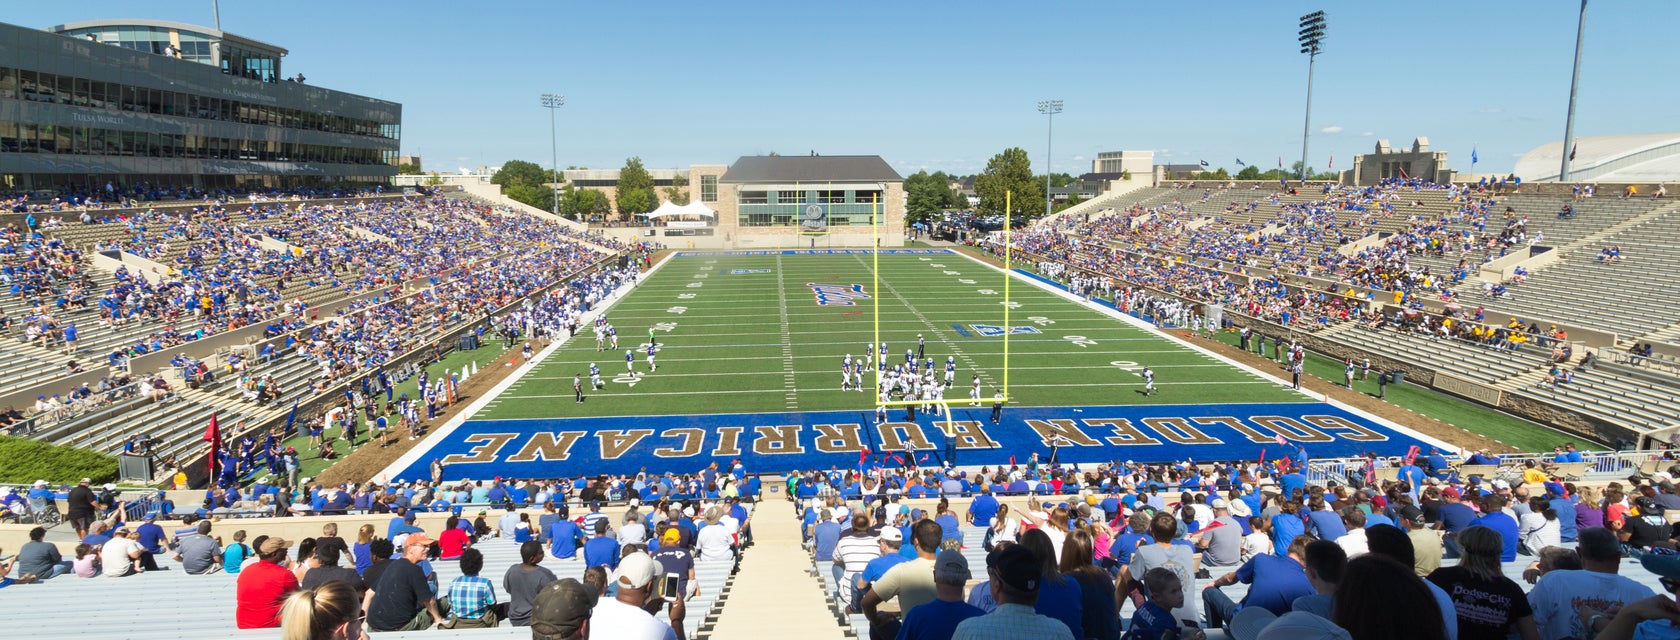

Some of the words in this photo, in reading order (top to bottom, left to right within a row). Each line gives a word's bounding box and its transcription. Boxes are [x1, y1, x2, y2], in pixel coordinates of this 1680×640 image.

[441, 420, 1002, 467] HURRICANE
[1024, 414, 1389, 447] GOLDEN
[1454, 584, 1489, 600] Dodge
[1489, 594, 1512, 608] City
